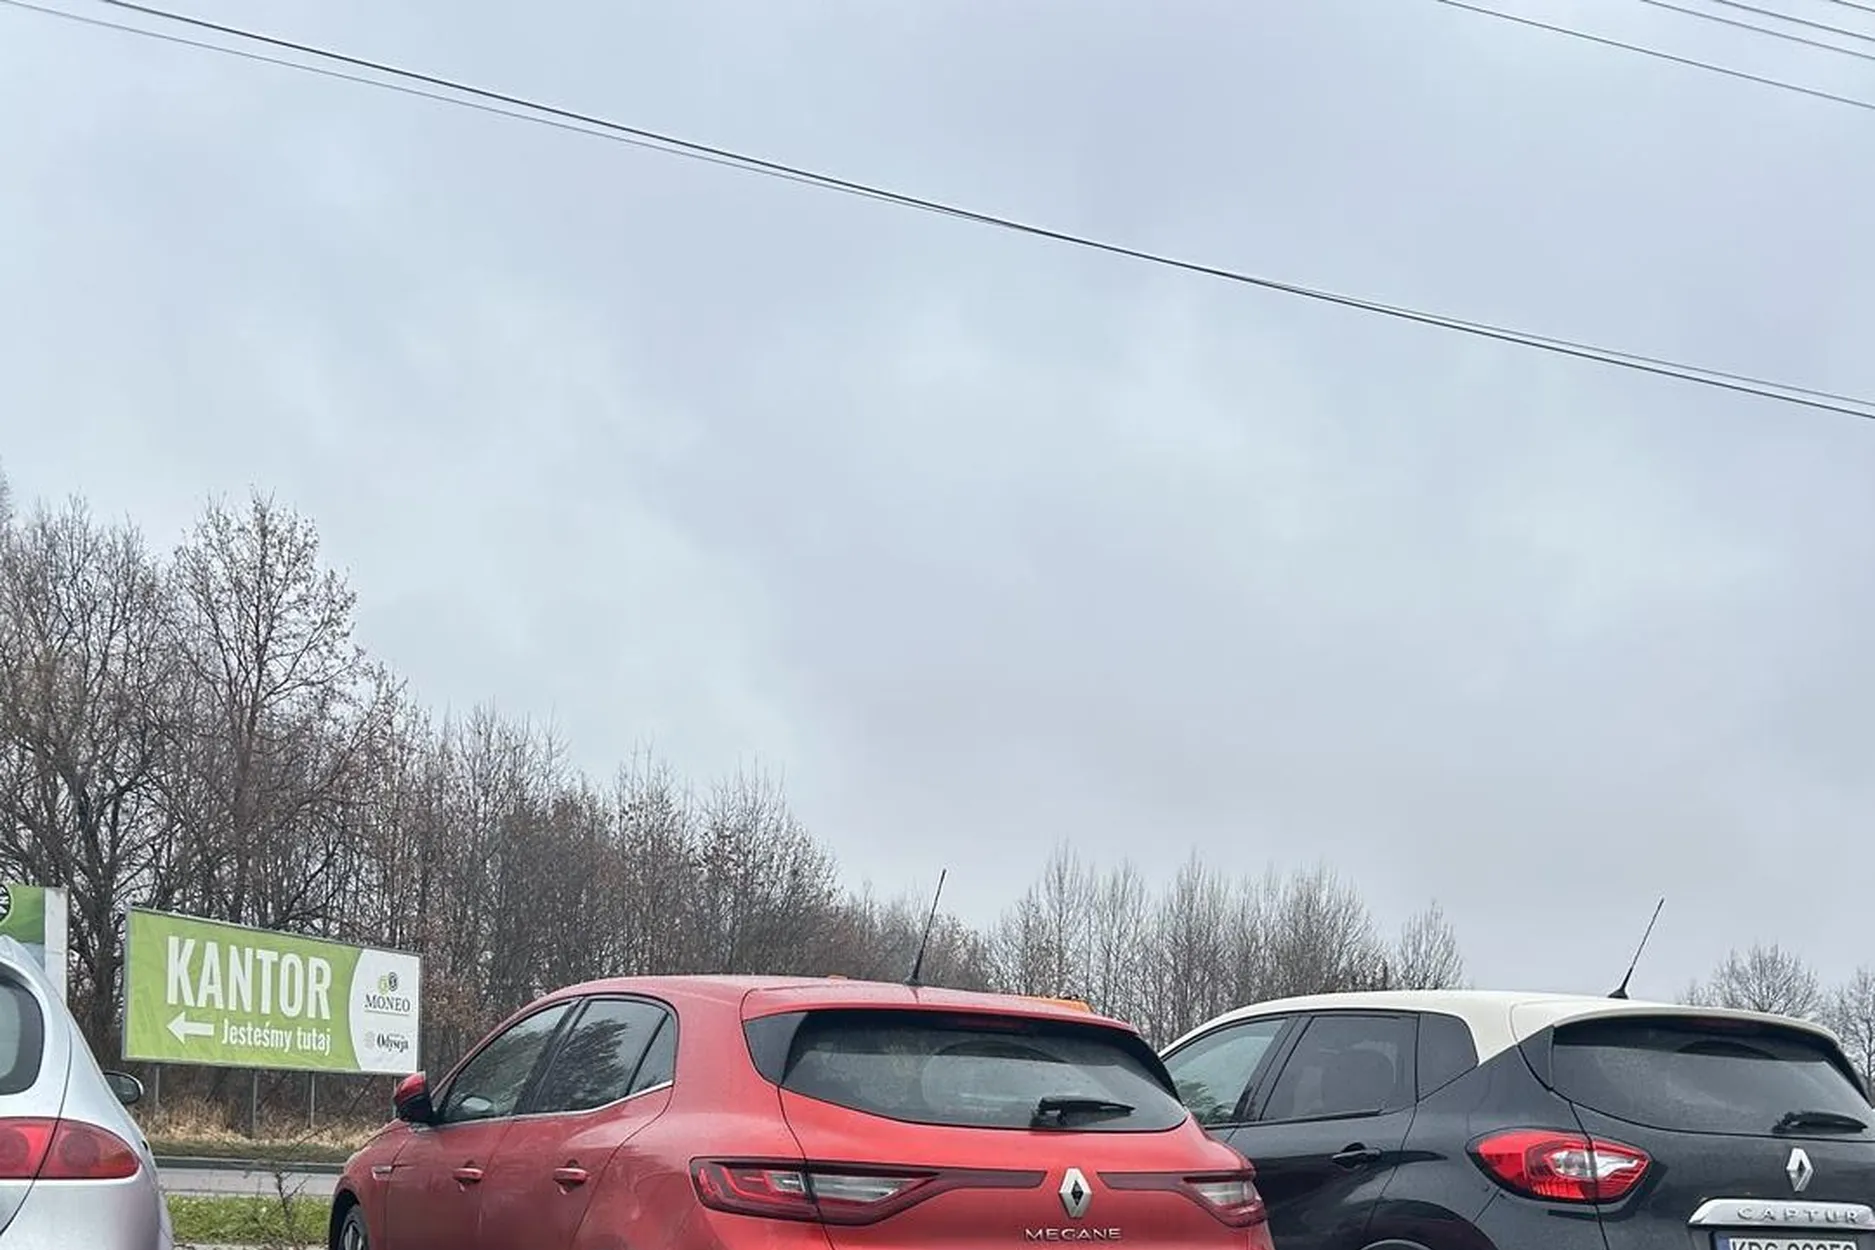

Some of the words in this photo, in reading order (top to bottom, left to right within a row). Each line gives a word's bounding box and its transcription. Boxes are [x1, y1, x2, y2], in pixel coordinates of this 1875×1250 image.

[167, 935, 332, 1020] KANTOR
[364, 993, 411, 1013] MONEO
[221, 1018, 293, 1053] Jesteśmy
[296, 1026, 331, 1056] tutaj
[1737, 1206, 1858, 1224] CAPTUR
[1025, 1228, 1122, 1241] MEGANE
